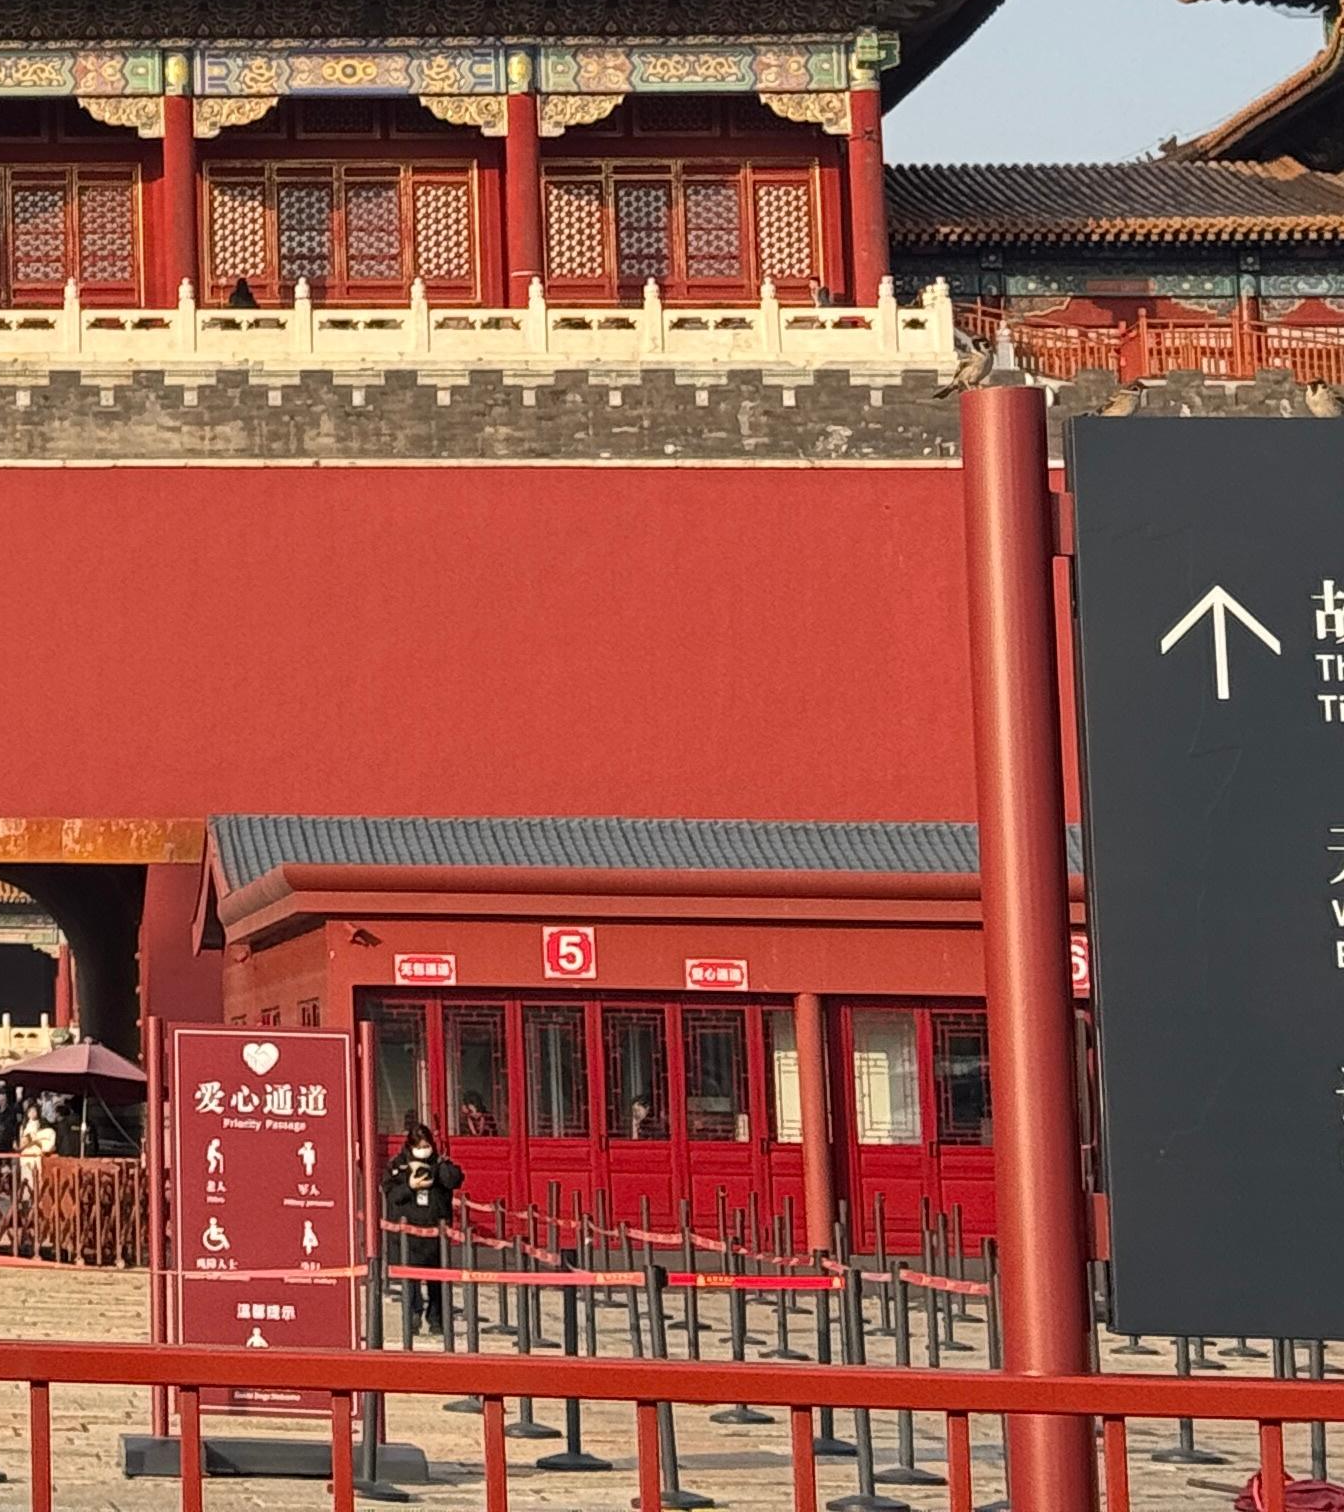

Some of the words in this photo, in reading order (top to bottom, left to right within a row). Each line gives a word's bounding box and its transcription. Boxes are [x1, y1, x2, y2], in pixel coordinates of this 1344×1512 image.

[558, 935, 583, 970] 5
[194, 1081, 328, 1117] 爱心通道
